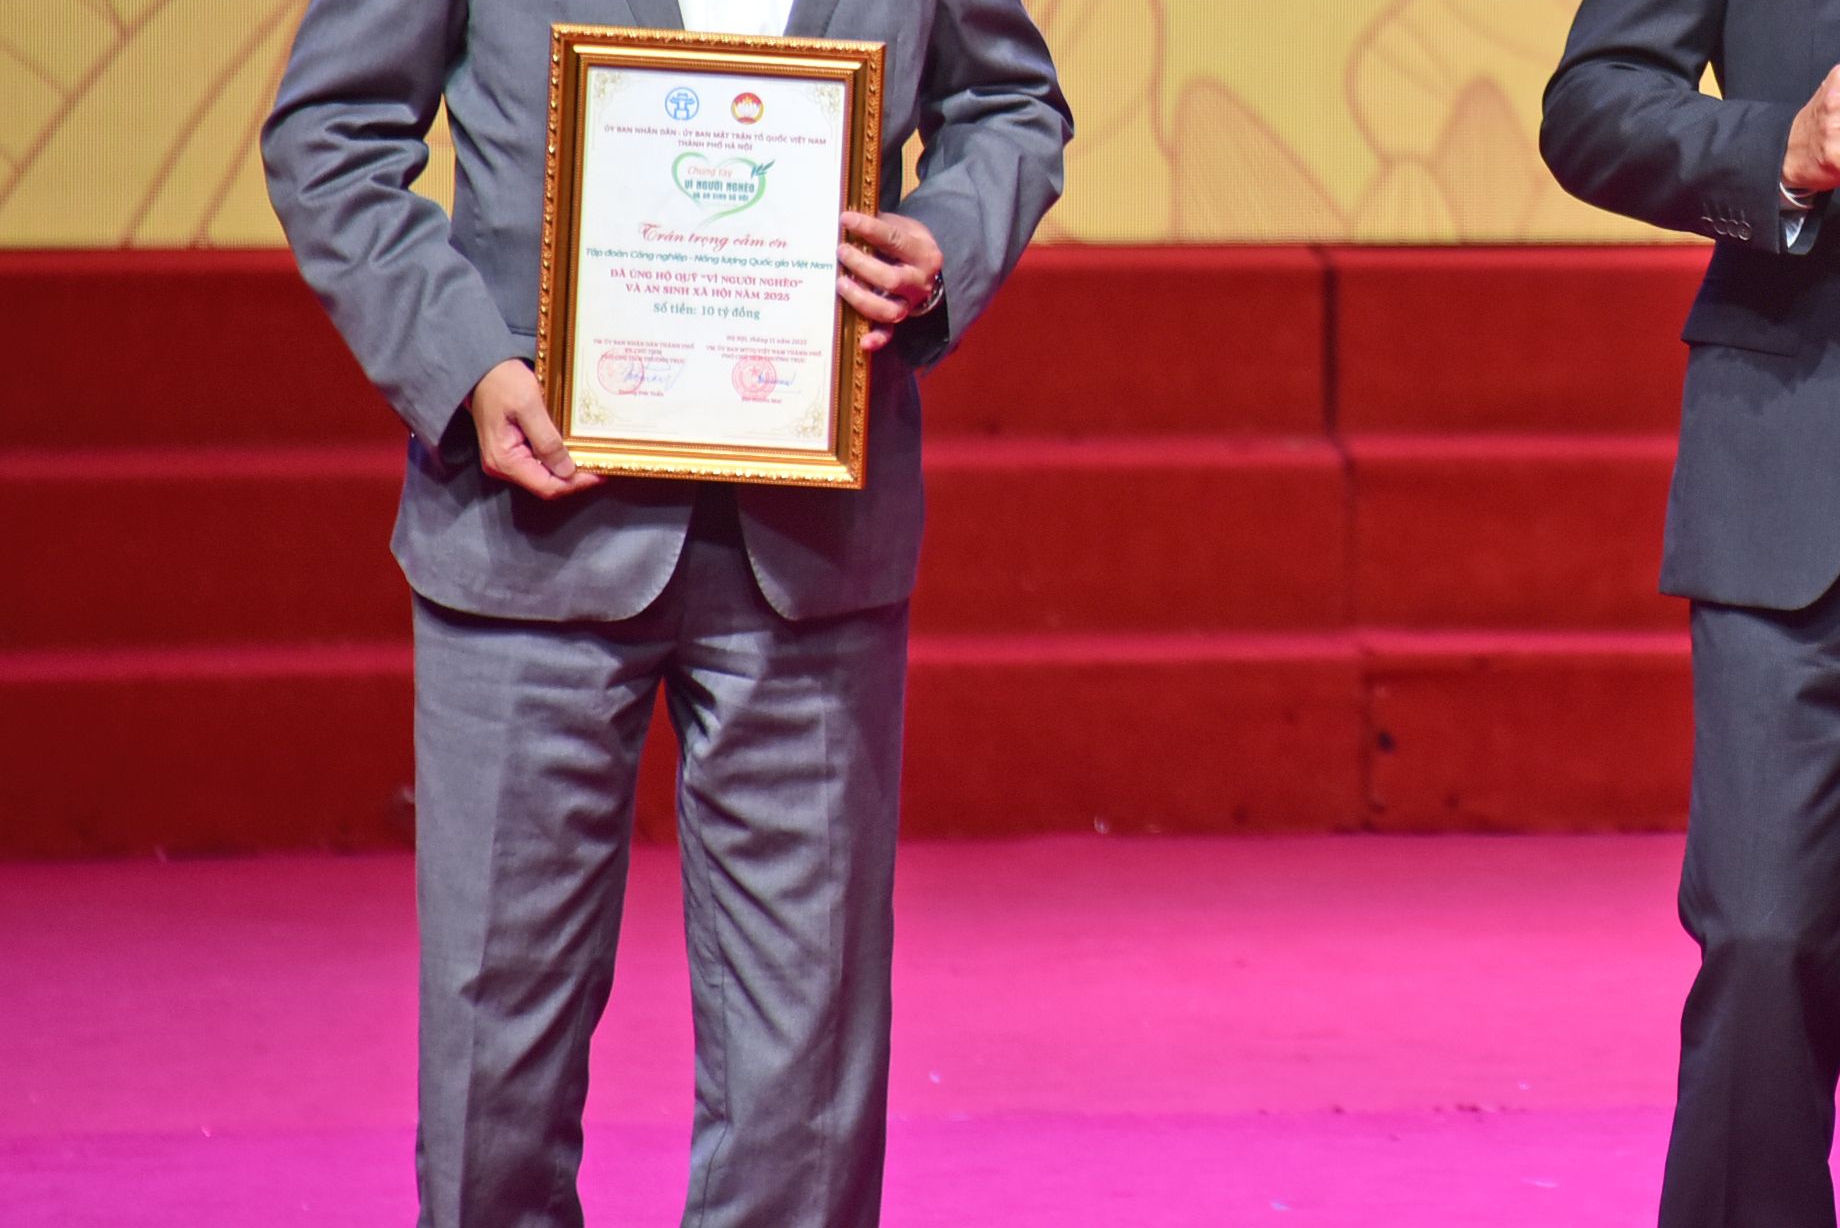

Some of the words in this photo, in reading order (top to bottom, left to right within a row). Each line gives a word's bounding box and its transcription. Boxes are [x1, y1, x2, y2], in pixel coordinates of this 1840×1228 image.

[644, 284, 660, 293] AN
[663, 285, 689, 296] SINH
[763, 291, 790, 302] 2025
[653, 302, 668, 313] Số
[702, 305, 714, 316] 10
[731, 306, 760, 320] đồng
